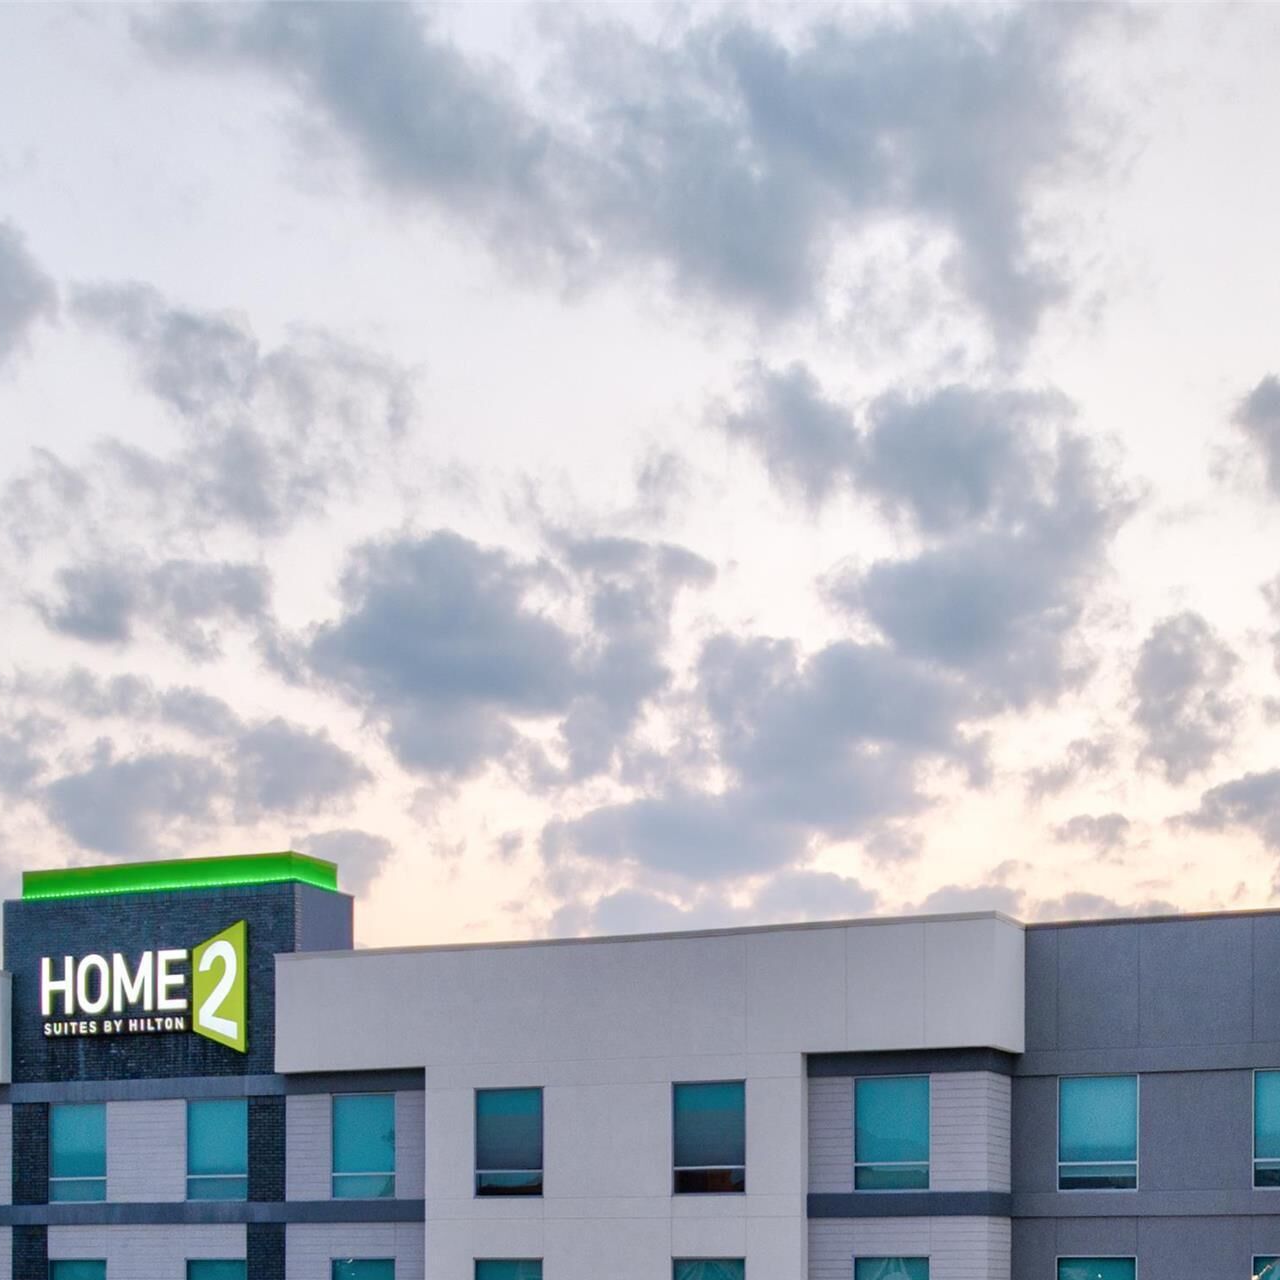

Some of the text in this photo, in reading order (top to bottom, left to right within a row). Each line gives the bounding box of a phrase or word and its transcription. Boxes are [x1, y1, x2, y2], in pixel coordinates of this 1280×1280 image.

[41, 939, 238, 1040] HOME 2
[43, 1016, 185, 1035] SUITES BY HILTON
